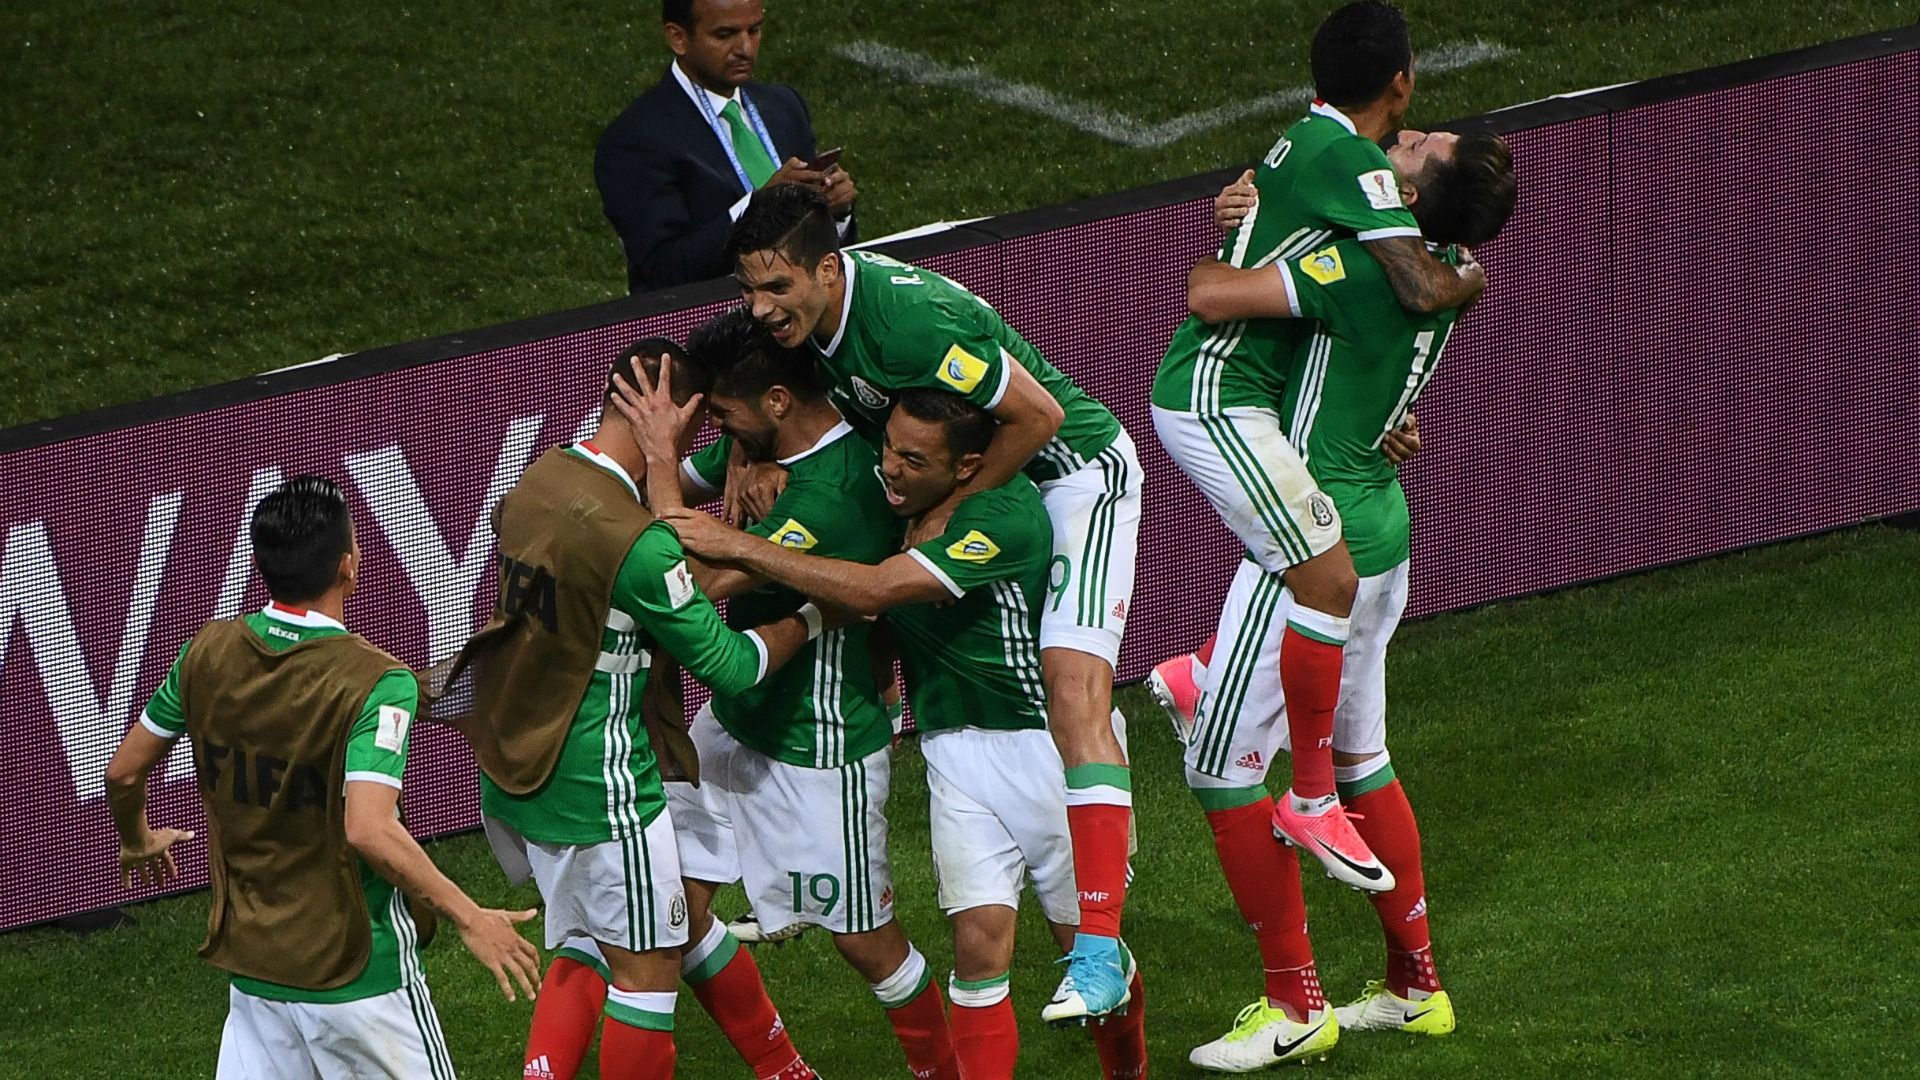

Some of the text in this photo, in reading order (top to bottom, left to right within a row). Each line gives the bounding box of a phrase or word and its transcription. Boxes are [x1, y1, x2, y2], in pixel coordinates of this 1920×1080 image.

[203, 740, 330, 812] FIFA
[1235, 760, 1264, 771] adidas
[787, 871, 840, 917] 19
[1077, 891, 1110, 903] FMF
